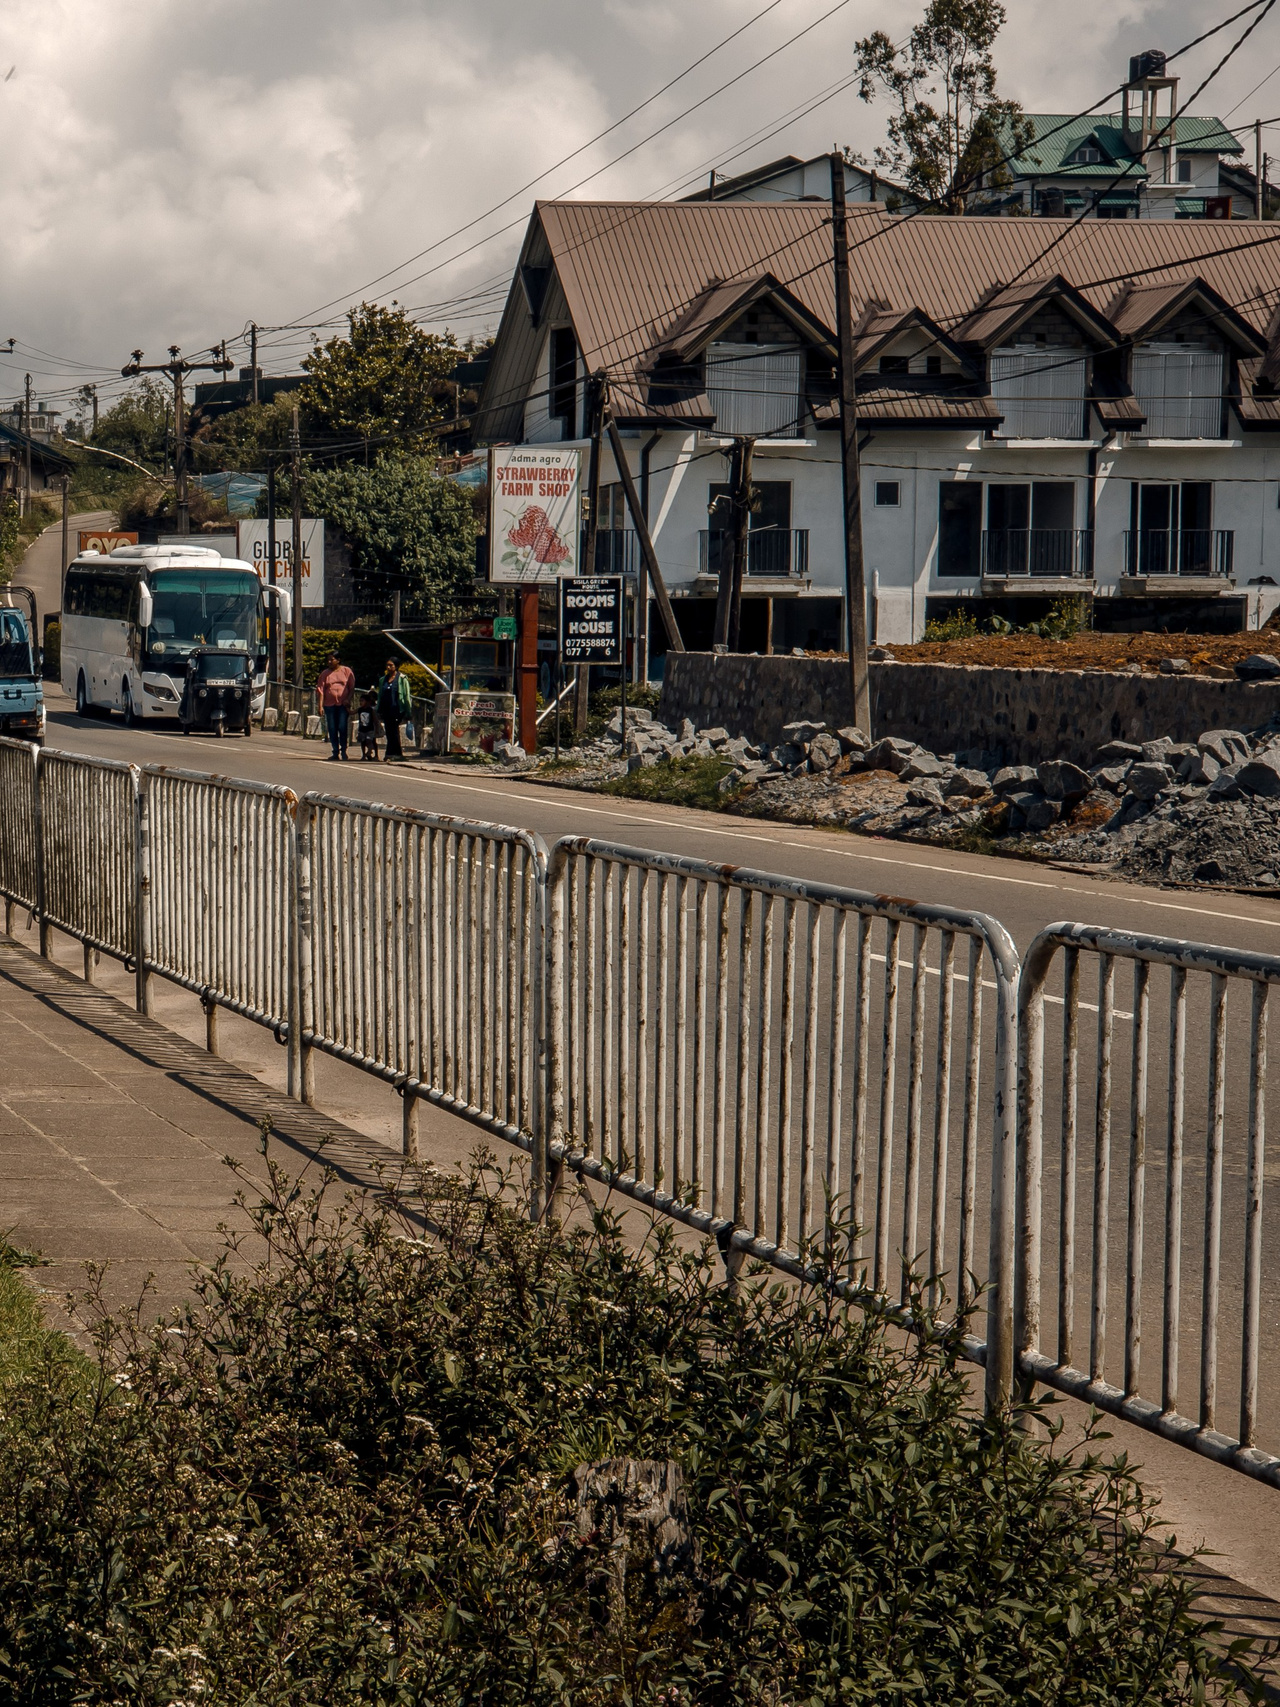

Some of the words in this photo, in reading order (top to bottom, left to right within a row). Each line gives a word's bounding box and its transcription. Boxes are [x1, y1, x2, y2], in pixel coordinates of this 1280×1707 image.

[511, 454, 537, 463] adma
[539, 456, 561, 466] agro
[496, 466, 576, 482] STRAWBERRY
[501, 482, 534, 496] FARM
[538, 482, 570, 497] SHOP
[253, 540, 311, 559] GLOBL
[253, 560, 311, 578] KICHN
[566, 594, 616, 608] ROOMS
[583, 610, 599, 620] OR
[569, 621, 614, 634] HOUSE
[565, 638, 616, 647] 0775588874
[469, 700, 496, 709] Fresh
[454, 708, 514, 719] Strawberries
